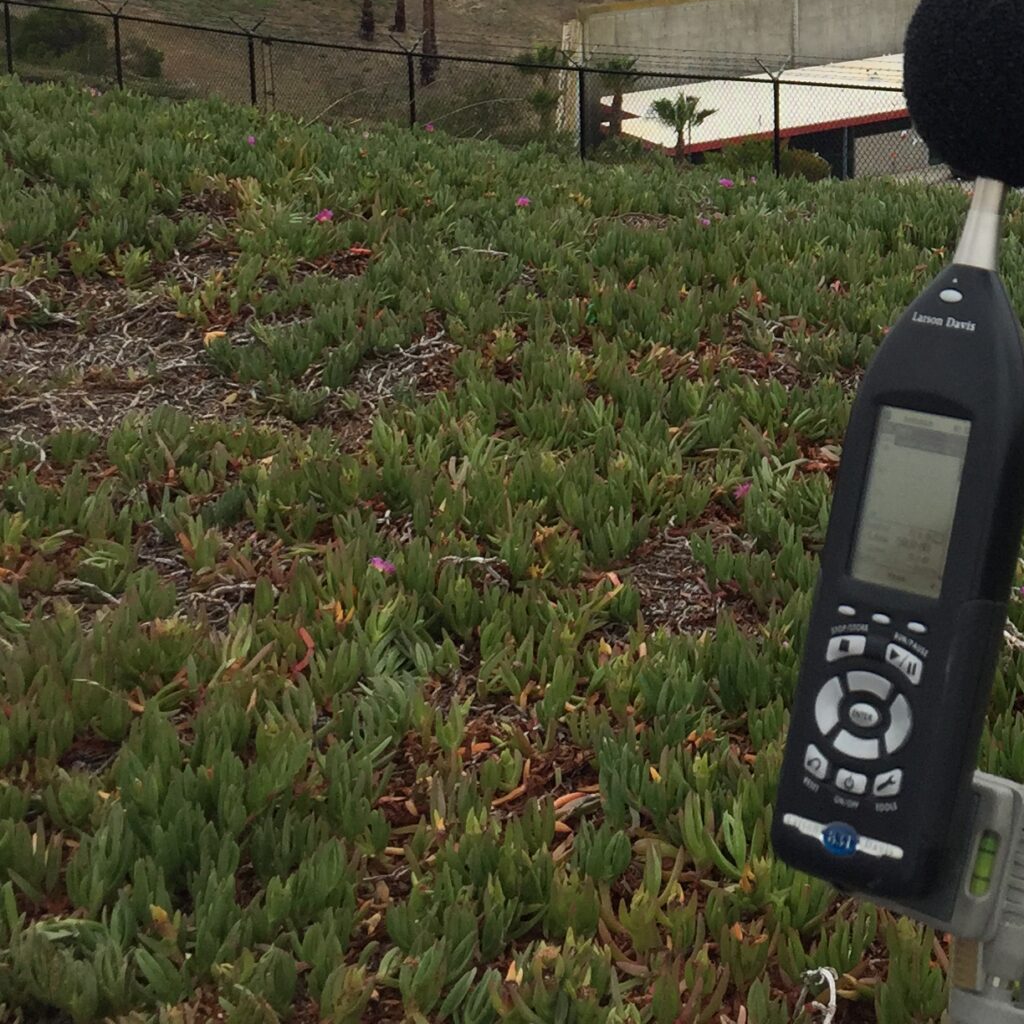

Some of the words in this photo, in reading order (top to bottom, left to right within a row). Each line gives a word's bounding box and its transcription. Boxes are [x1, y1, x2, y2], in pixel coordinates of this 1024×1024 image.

[912, 311, 944, 326] Larson
[945, 316, 976, 332] Davis
[875, 801, 898, 813] TOOLS
